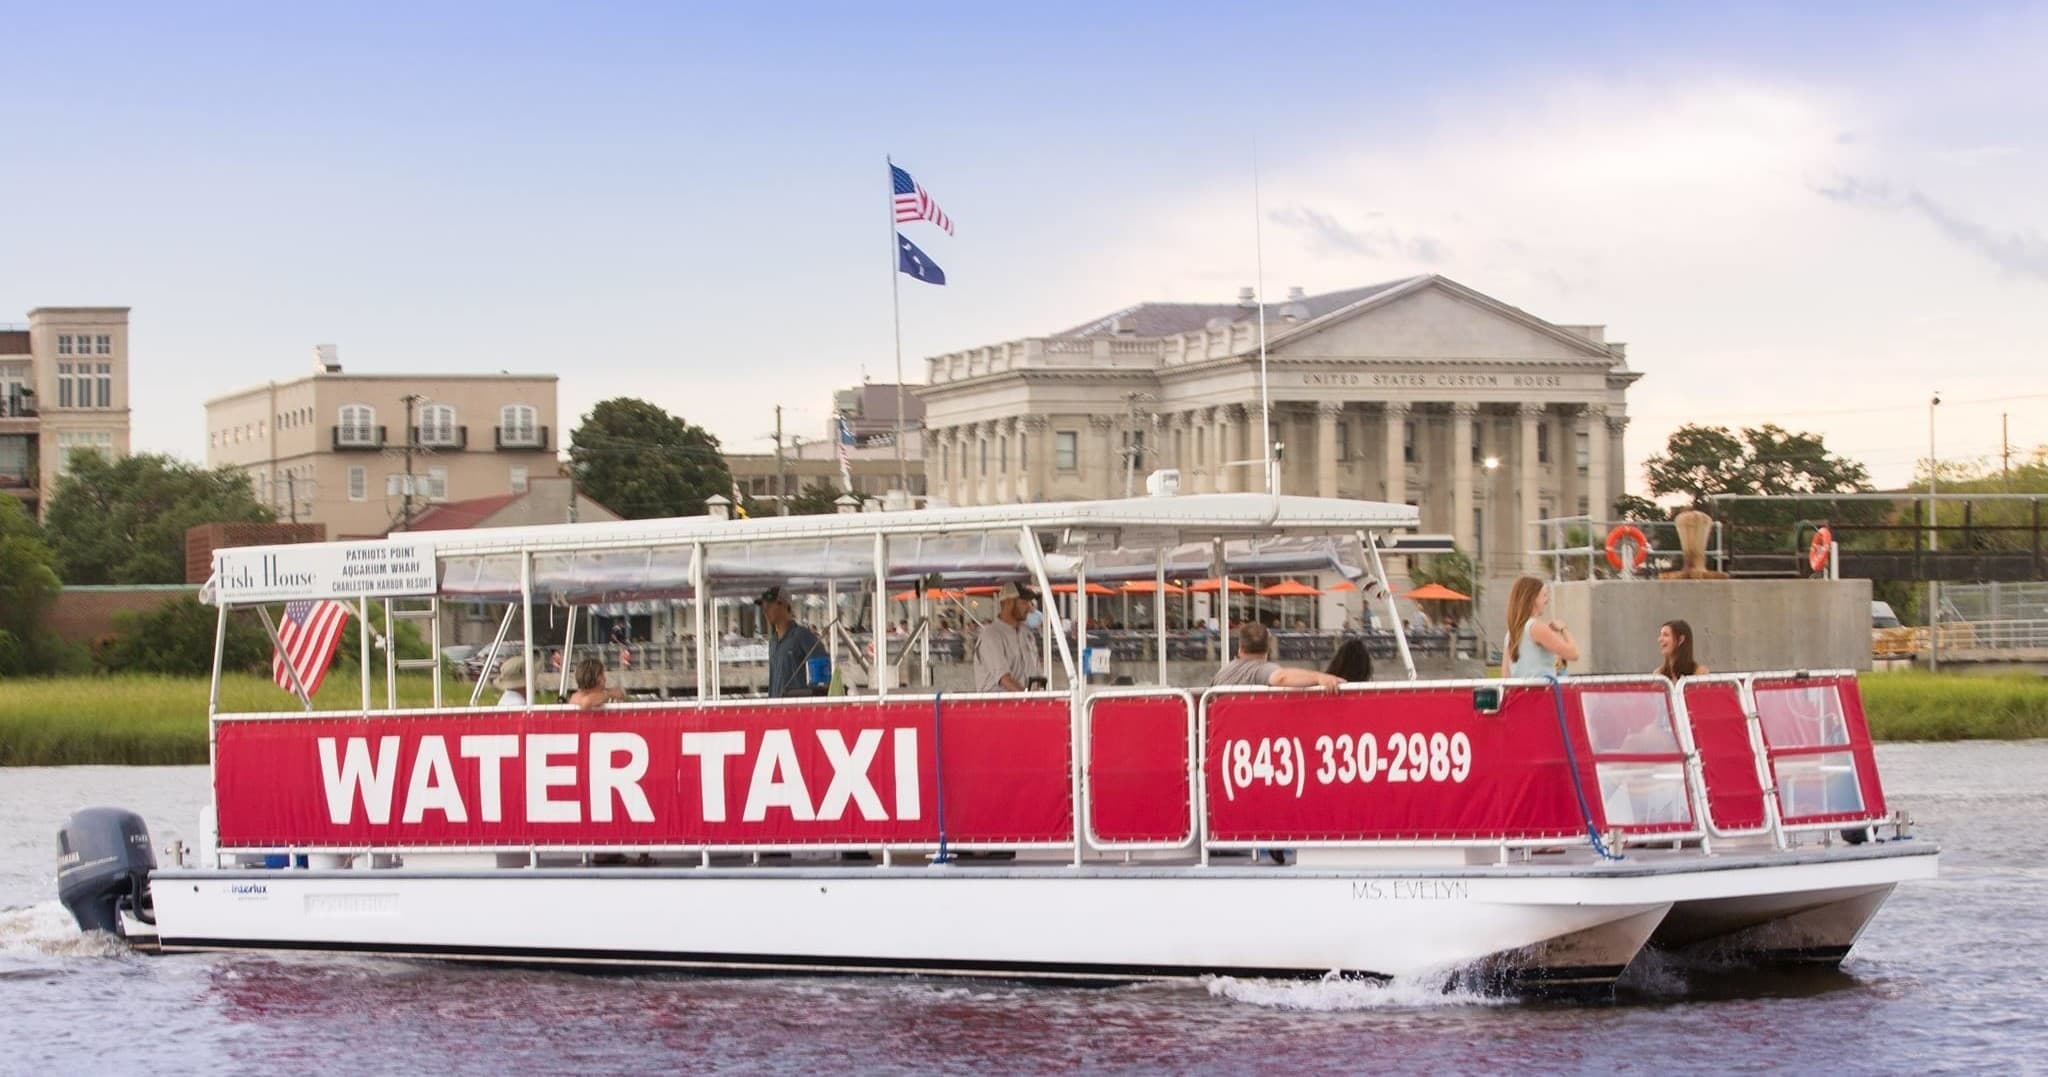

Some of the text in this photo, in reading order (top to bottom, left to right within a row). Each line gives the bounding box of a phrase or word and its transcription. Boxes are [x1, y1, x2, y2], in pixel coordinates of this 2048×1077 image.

[1302, 374, 1561, 387] UNITED STATES CUSTOM HOUSE
[346, 546, 415, 560] PATRIOTS POINT
[220, 553, 317, 589] Fish House
[342, 561, 420, 577] AQUARIUM WHARF
[332, 577, 432, 593] CHARLESTON HARBOR RESORT
[1222, 731, 1472, 801] (843) 330-2989
[317, 727, 921, 825] WATER TAXI
[1352, 880, 1469, 900] MS. EVELYN
